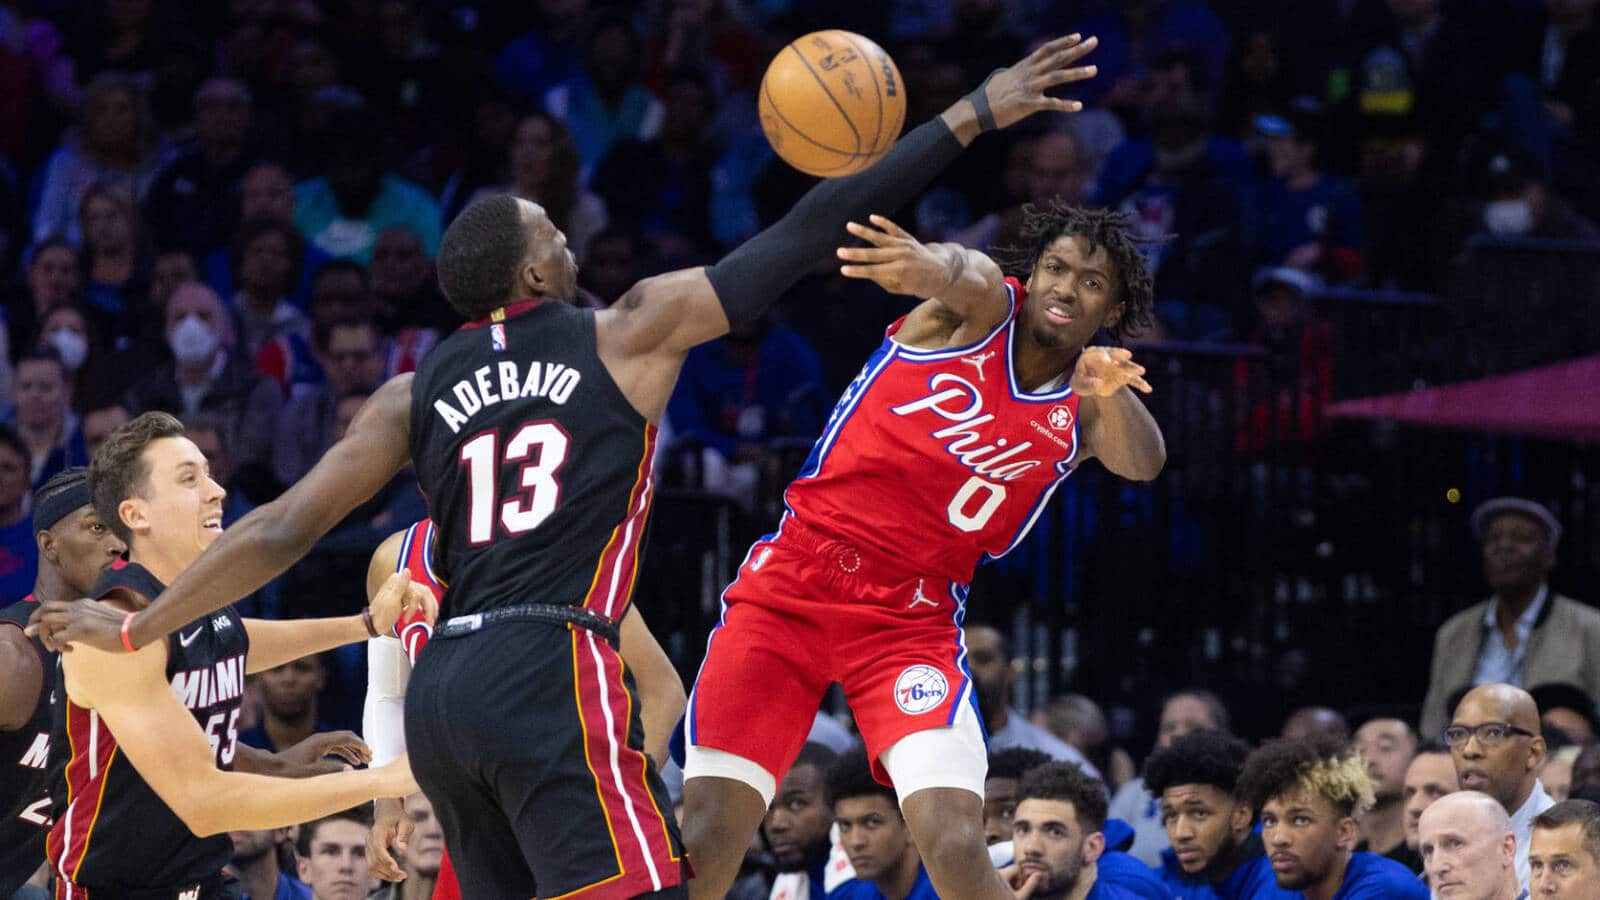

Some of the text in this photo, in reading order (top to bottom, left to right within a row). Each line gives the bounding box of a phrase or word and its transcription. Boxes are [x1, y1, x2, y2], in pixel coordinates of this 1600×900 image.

[433, 361, 582, 434] ADEBAYO
[890, 373, 1041, 481] Phila
[1030, 419, 1069, 449] crypto.com
[459, 419, 573, 547] 13
[947, 476, 1006, 532] 0
[170, 654, 245, 709] MIAMI
[900, 683, 942, 704] 76ers
[205, 707, 241, 765] 55
